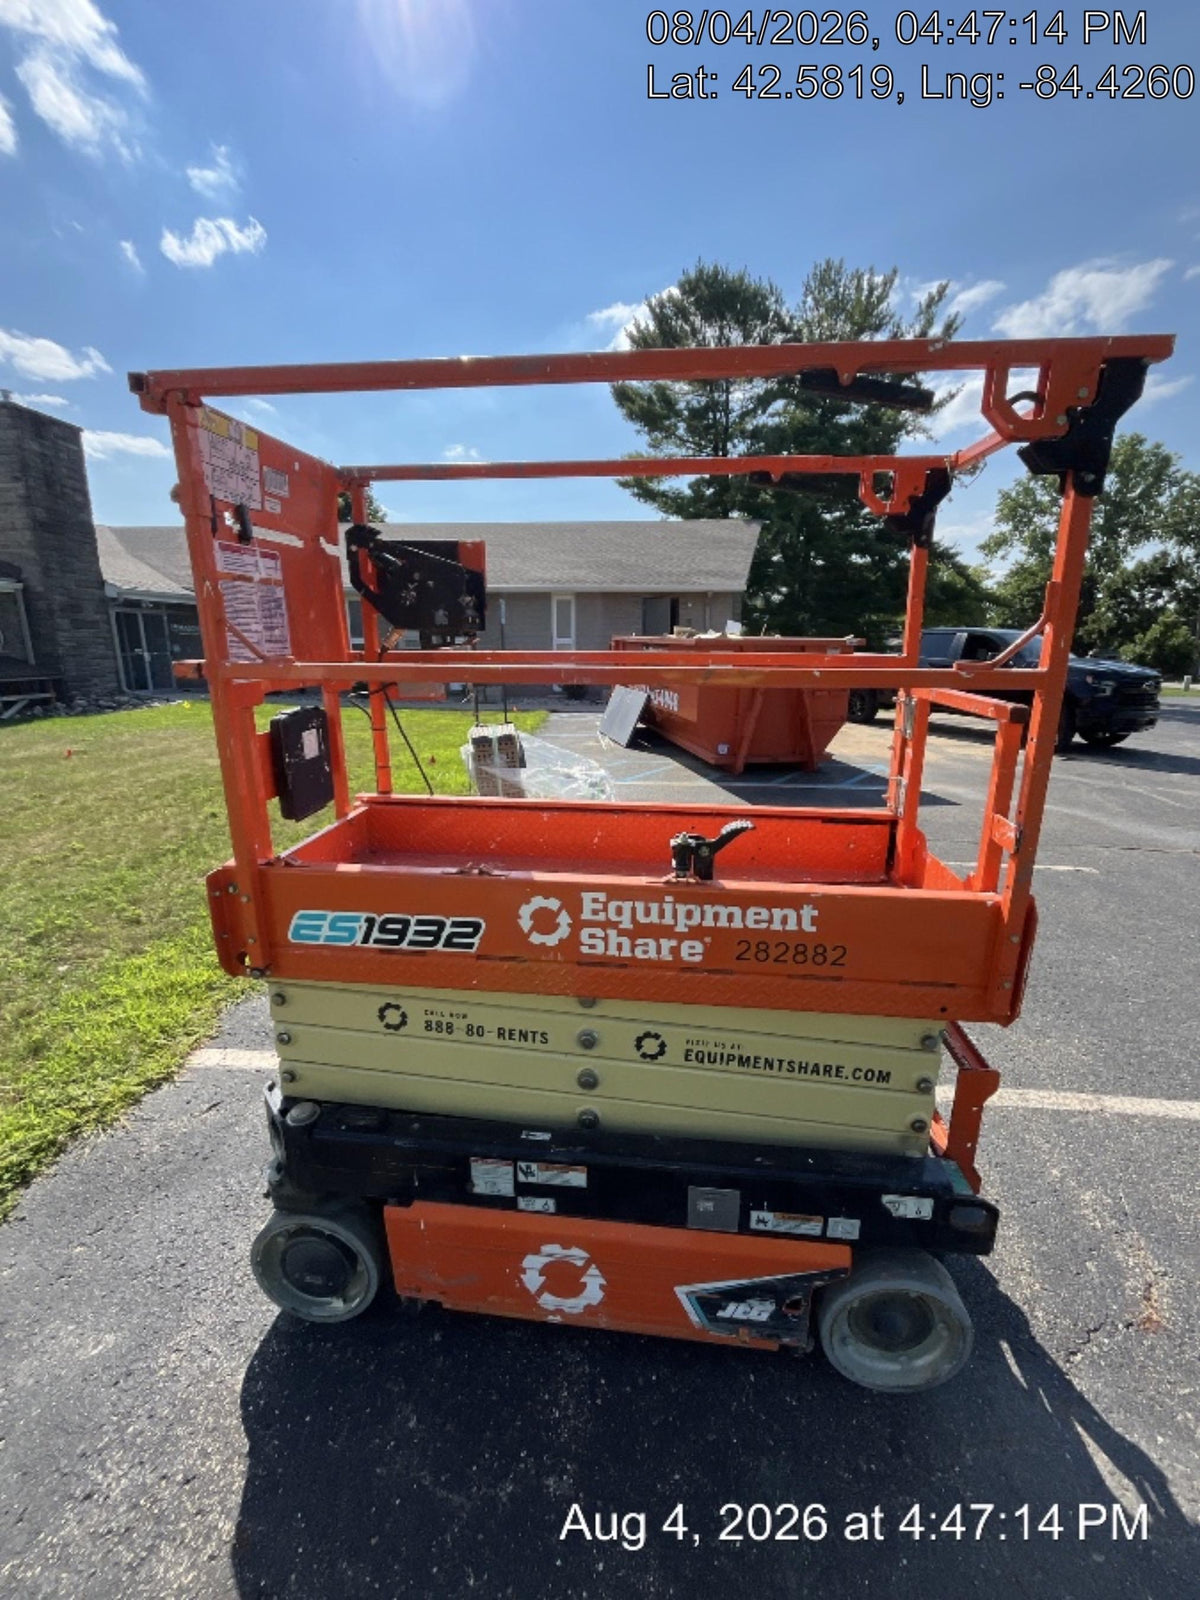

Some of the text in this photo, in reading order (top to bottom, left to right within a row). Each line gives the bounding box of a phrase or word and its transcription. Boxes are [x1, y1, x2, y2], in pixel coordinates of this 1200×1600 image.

[580, 891, 819, 933] Equipment
[287, 909, 486, 954] ES1932
[579, 927, 706, 963] Share
[735, 939, 849, 967] 282882
[683, 1048, 892, 1084] EQUIPMENTSHARE.COM
